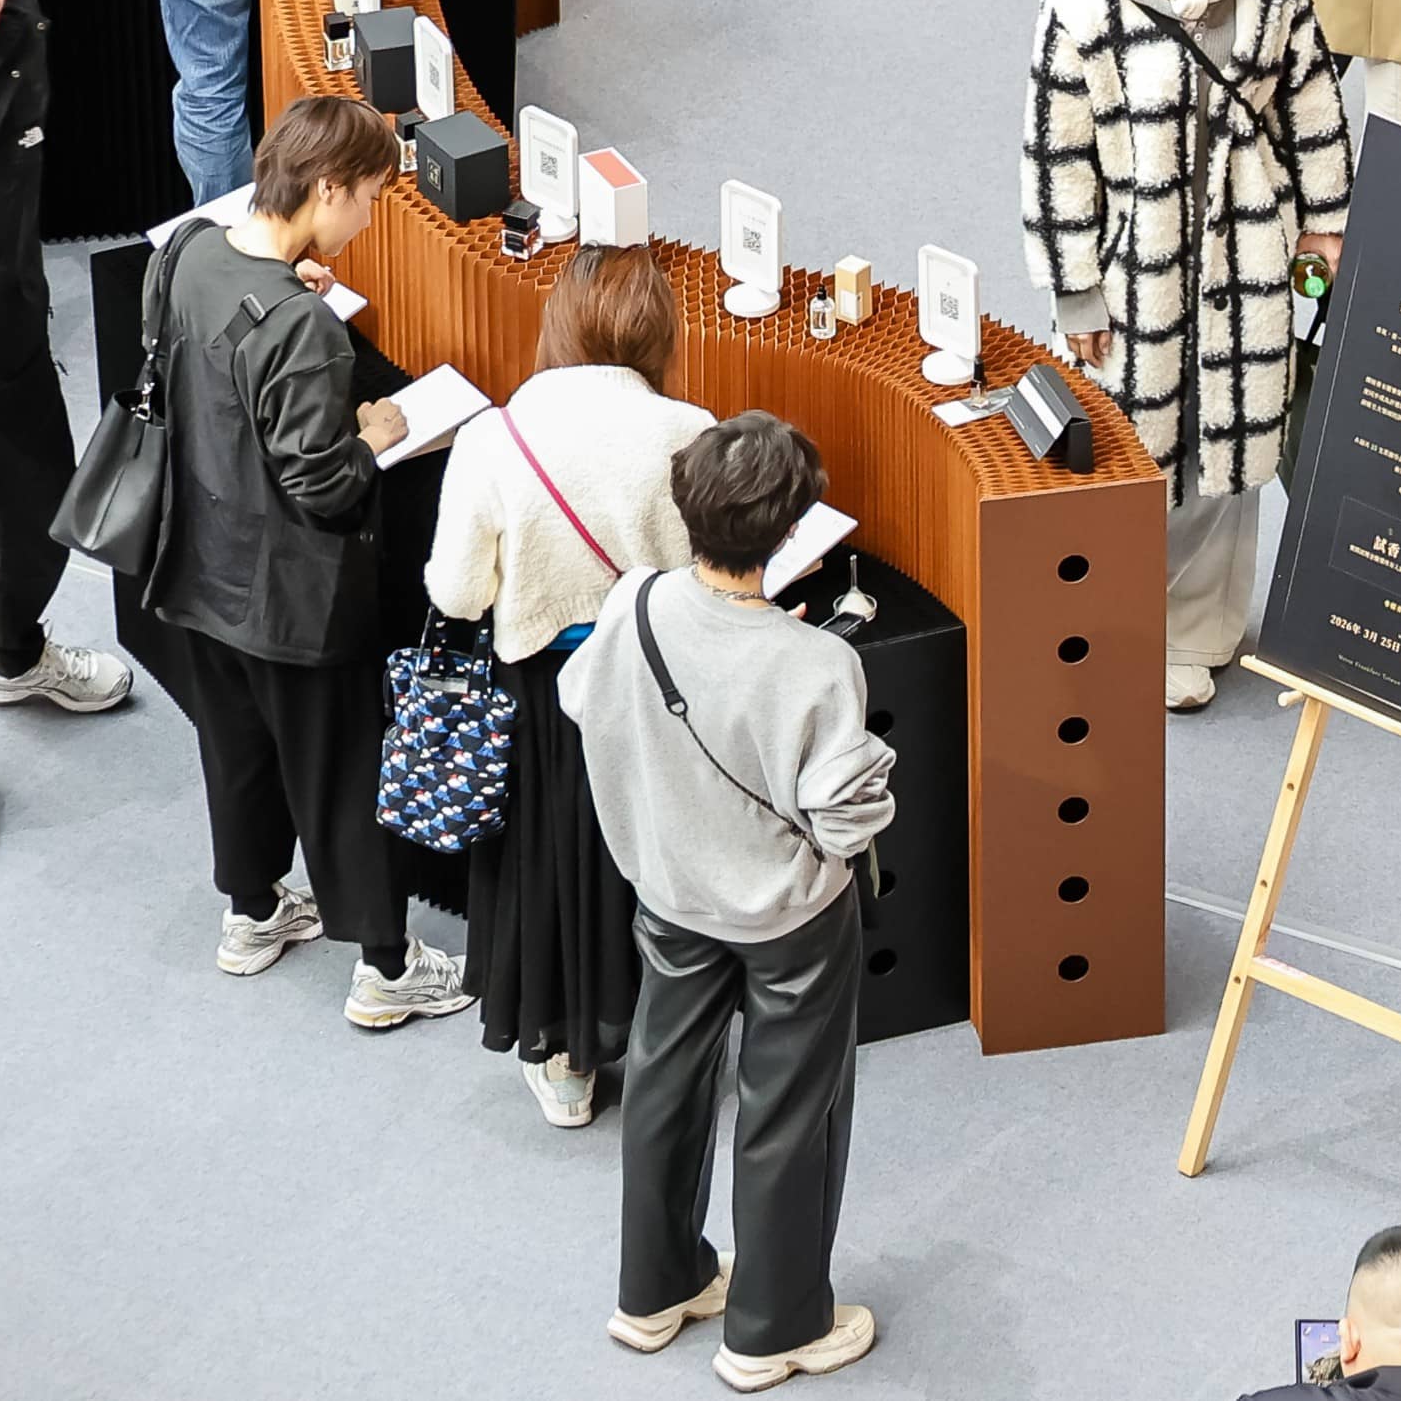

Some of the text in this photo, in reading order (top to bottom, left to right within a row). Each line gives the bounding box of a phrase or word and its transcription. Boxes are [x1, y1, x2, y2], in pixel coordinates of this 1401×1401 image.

[1372, 535, 1401, 559] 試香
[1329, 614, 1361, 635] 2026年
[1362, 628, 1378, 643] 3月
[1380, 636, 1401, 653] 25日
